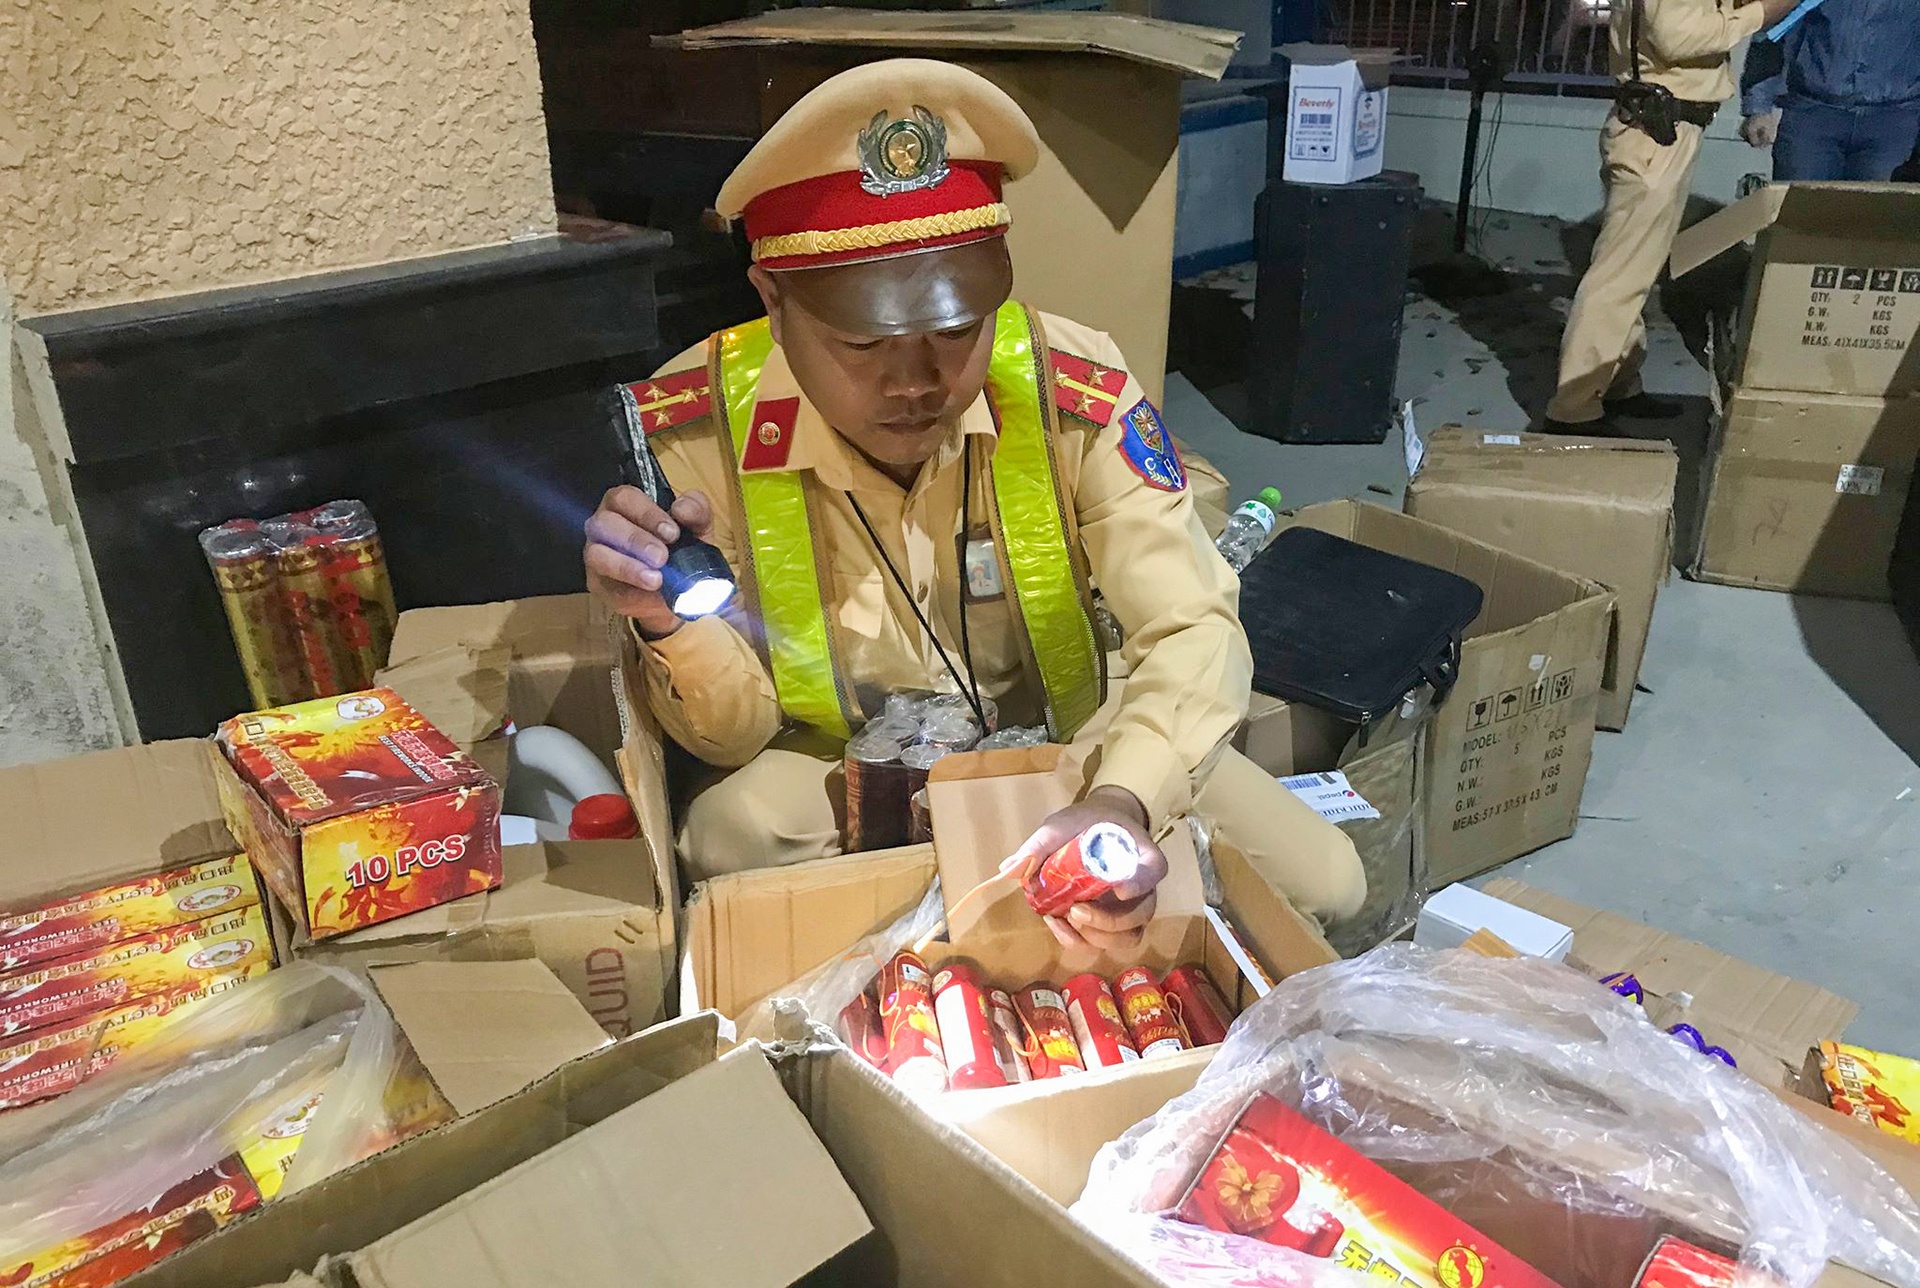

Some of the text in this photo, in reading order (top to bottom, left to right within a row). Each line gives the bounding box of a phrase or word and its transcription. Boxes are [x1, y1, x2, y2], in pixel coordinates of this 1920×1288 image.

[1853, 294, 1860, 305] 2
[1876, 295, 1897, 307] PCS
[1872, 310, 1893, 321] KGS
[1869, 324, 1890, 336] KGS
[1547, 726, 1567, 742] PCS
[1543, 745, 1564, 761] KGS
[1541, 763, 1561, 780] KGS
[1544, 781, 1558, 797] CM
[346, 834, 466, 888] 10 PCS
[13, 925, 85, 947] FIREWORKS
[13, 987, 88, 1011] FIREWORKS
[3, 1057, 82, 1087] FIREWORKS
